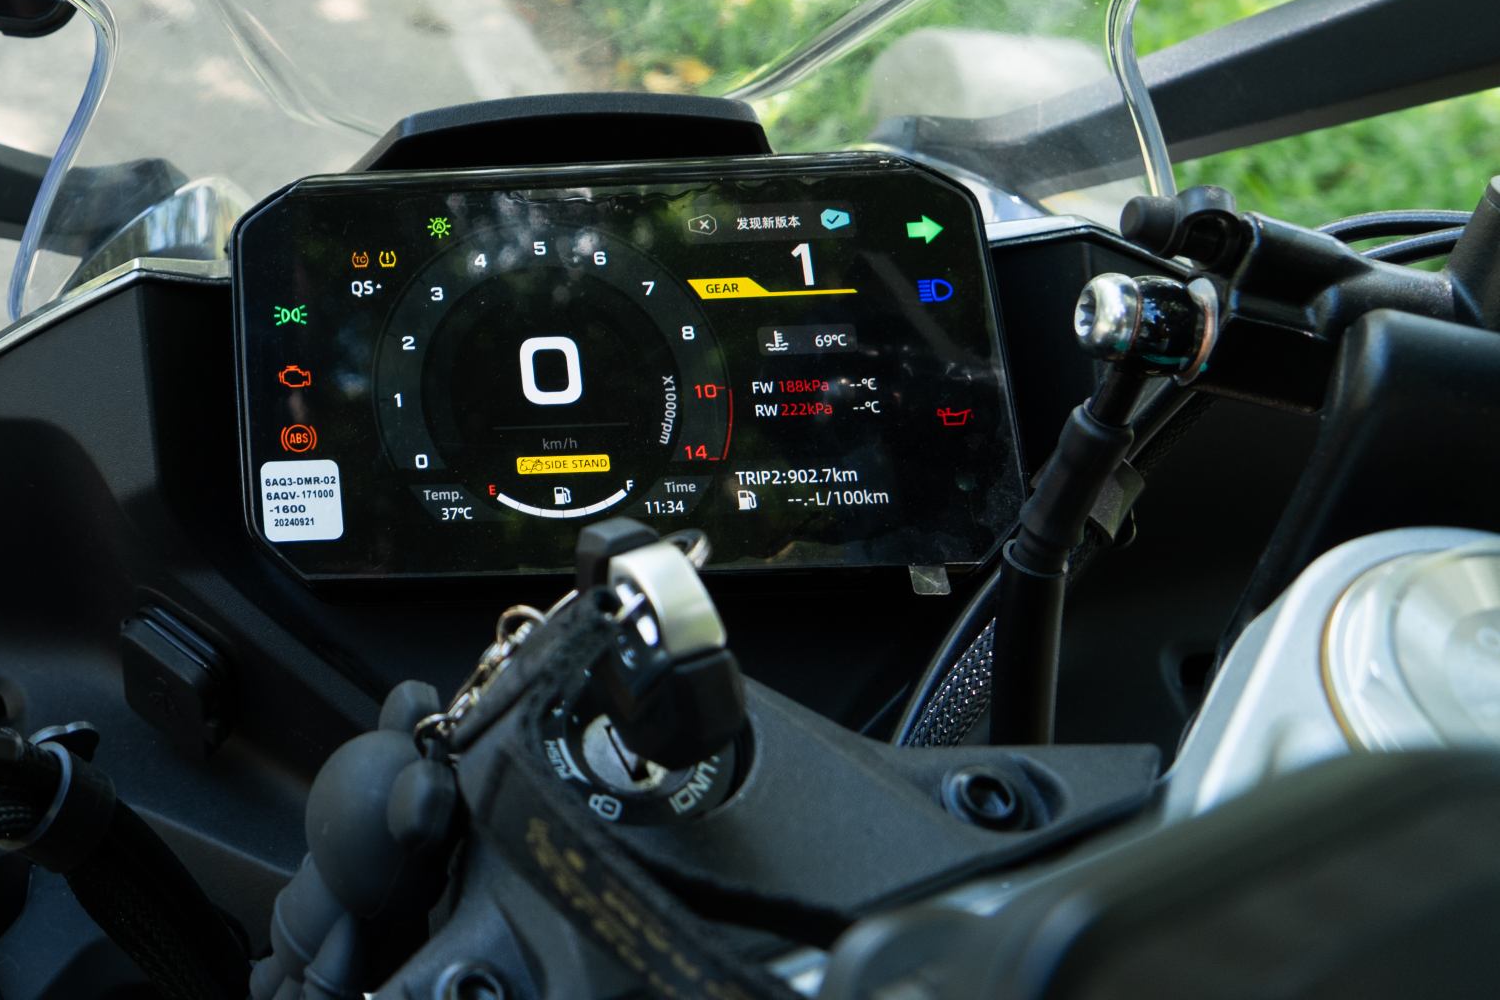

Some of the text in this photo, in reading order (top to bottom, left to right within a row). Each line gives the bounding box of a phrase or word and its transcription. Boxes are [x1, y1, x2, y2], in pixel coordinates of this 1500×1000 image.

[736, 215, 801, 231] 发现新版本
[533, 241, 546, 256] 5
[474, 253, 488, 268] 4
[593, 251, 607, 266] 6
[790, 243, 815, 286] 1
[351, 280, 374, 297] QS
[430, 286, 444, 301] 3
[642, 281, 655, 296] 7
[705, 283, 740, 294] GEAR
[681, 325, 695, 340] 8
[401, 335, 415, 350] 2
[519, 336, 583, 405] 0
[694, 384, 717, 399] 10
[751, 380, 774, 394] FW
[778, 379, 830, 393] 188kPa
[394, 392, 402, 408] 1
[755, 403, 778, 417] RW
[780, 402, 833, 417] 222kPa
[289, 432, 309, 445] ABS
[542, 437, 578, 450] km/h
[684, 444, 707, 460] 14
[415, 453, 429, 469] 0
[544, 459, 608, 470] SIDE STAND
[265, 475, 337, 487] 6AQ3-DMR-02
[735, 467, 858, 486] TRIP2:902.7km
[488, 484, 497, 496] E
[626, 480, 634, 491] F
[664, 481, 697, 493] Time
[423, 489, 464, 503] Temp.
[644, 500, 685, 514] 11:34
[274, 517, 315, 528] 20240921
